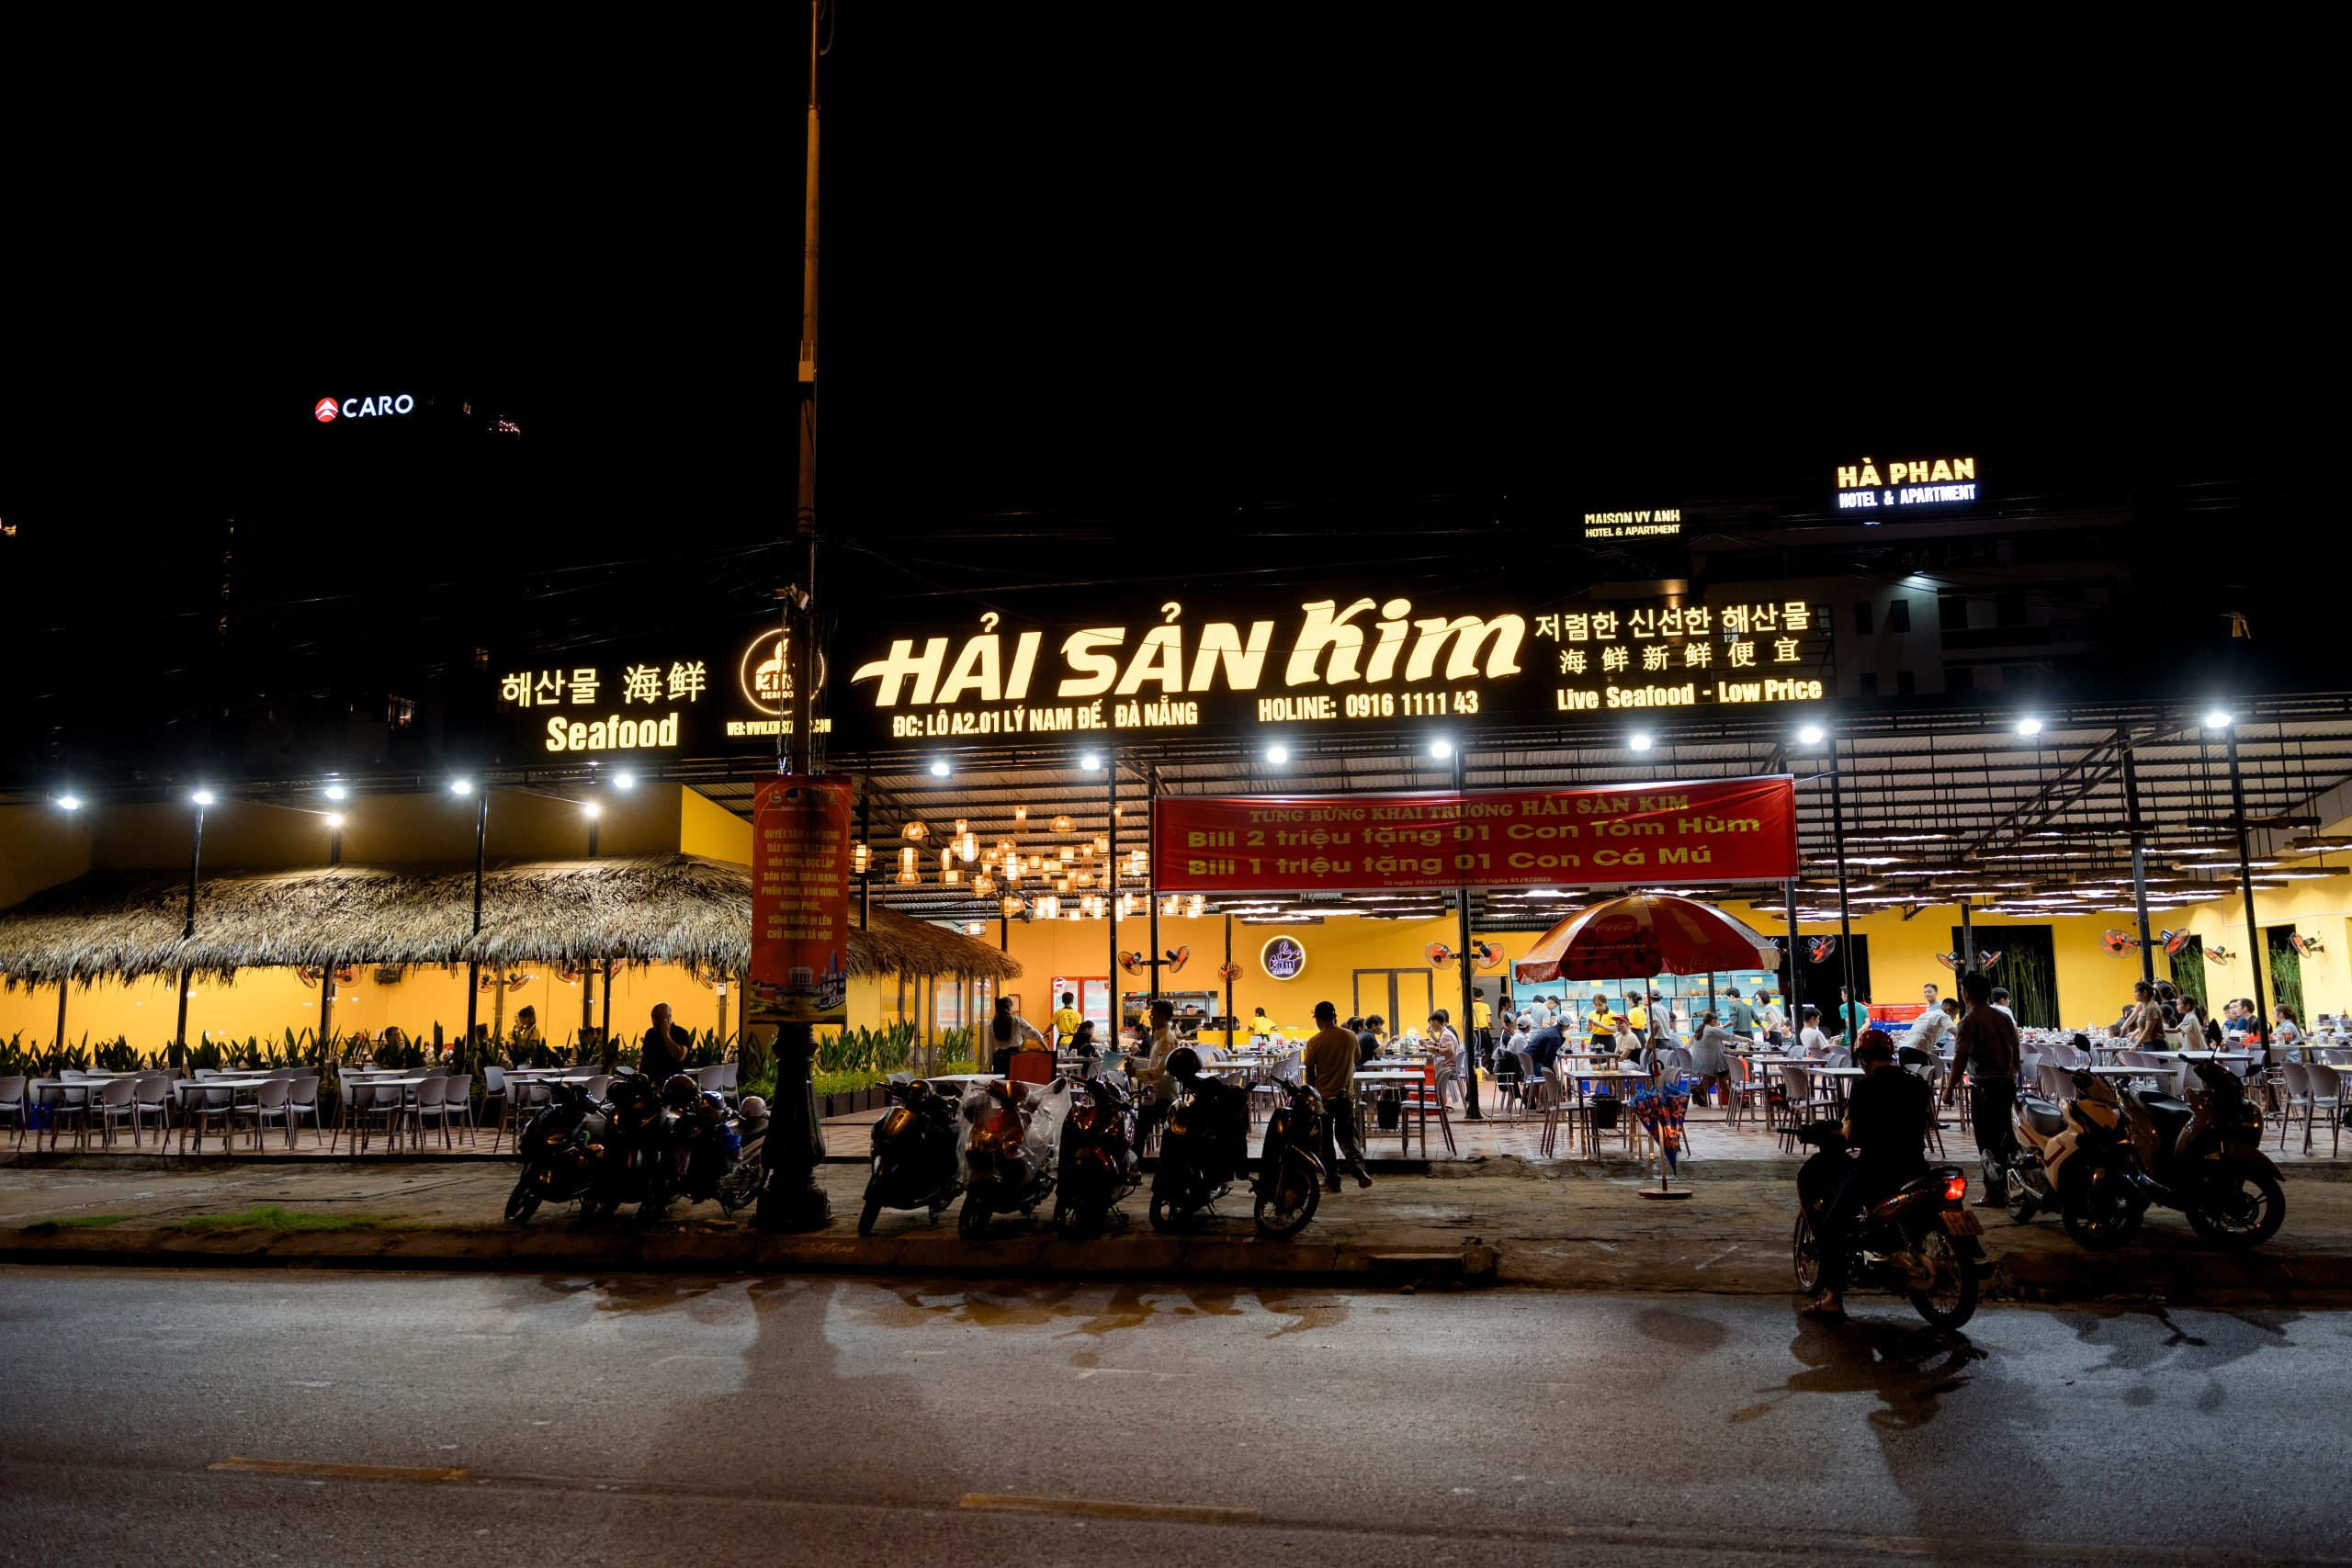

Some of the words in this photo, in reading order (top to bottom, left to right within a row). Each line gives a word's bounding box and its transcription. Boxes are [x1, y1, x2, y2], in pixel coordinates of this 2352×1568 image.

[342, 394, 413, 418] CARO
[1838, 457, 1882, 488] HÀ
[1889, 458, 1974, 484] PHAN
[1839, 491, 1878, 508] HOTEL
[1883, 491, 1894, 505] &
[1900, 484, 1975, 504] APARTMENT
[1585, 512, 1633, 525] MAISON
[1634, 511, 1651, 523] VY
[1654, 509, 1680, 522] ANH
[1585, 527, 1614, 537] HOTEL
[1615, 527, 1623, 536] &
[1625, 525, 1680, 536] APARTMENT
[1535, 611, 1619, 642] 저렴한
[1628, 606, 1712, 638] 신선한
[1722, 602, 1811, 633] 해산물
[851, 612, 1042, 707] HẢI
[1057, 602, 1274, 697] SẢN
[1285, 597, 1526, 687] Kim
[502, 669, 600, 707] 해산물
[623, 660, 707, 705] 海鲜
[761, 691, 794, 700] SEAFOO
[1557, 689, 1599, 710] Live
[1607, 682, 1694, 708] Seafood
[1719, 682, 1760, 703] Low
[1765, 678, 1823, 702] Price
[892, 716, 923, 738] ĐC:
[926, 709, 948, 736] LÔ
[951, 711, 1000, 736] A2.01
[1004, 705, 1026, 732] LÝ
[1029, 707, 1072, 731] NAM
[1114, 700, 1141, 728] ĐÀ
[1145, 694, 1198, 727] NẴNG
[1259, 695, 1337, 722] HOLINE:
[1345, 694, 1394, 717] 0916
[1401, 692, 1447, 716] 1111
[1453, 691, 1479, 714] 43
[546, 712, 678, 751] Seafood
[727, 722, 746, 736] WEB:
[1372, 806, 1423, 820] KHAI
[1521, 795, 1568, 816] HẢI
[1576, 794, 1630, 814] SẢN
[1639, 795, 1690, 812] KIM
[1188, 830, 1235, 848] Bill
[1247, 830, 1265, 846] 2
[1276, 828, 1351, 850] triệu
[1363, 827, 1442, 849] tặng
[1453, 824, 1490, 841] 01
[1507, 823, 1579, 840] Con
[1590, 819, 1665, 837] Tôm
[1679, 816, 1759, 834] Hùm
[1188, 859, 1235, 875] Bill
[1250, 859, 1261, 874] 1
[1276, 856, 1351, 877] triệu
[1363, 855, 1442, 876] tặng
[1454, 852, 1491, 869] 01
[1508, 852, 1580, 868] Con
[1592, 848, 1645, 866] Cá
[1659, 845, 1712, 864] Mú
